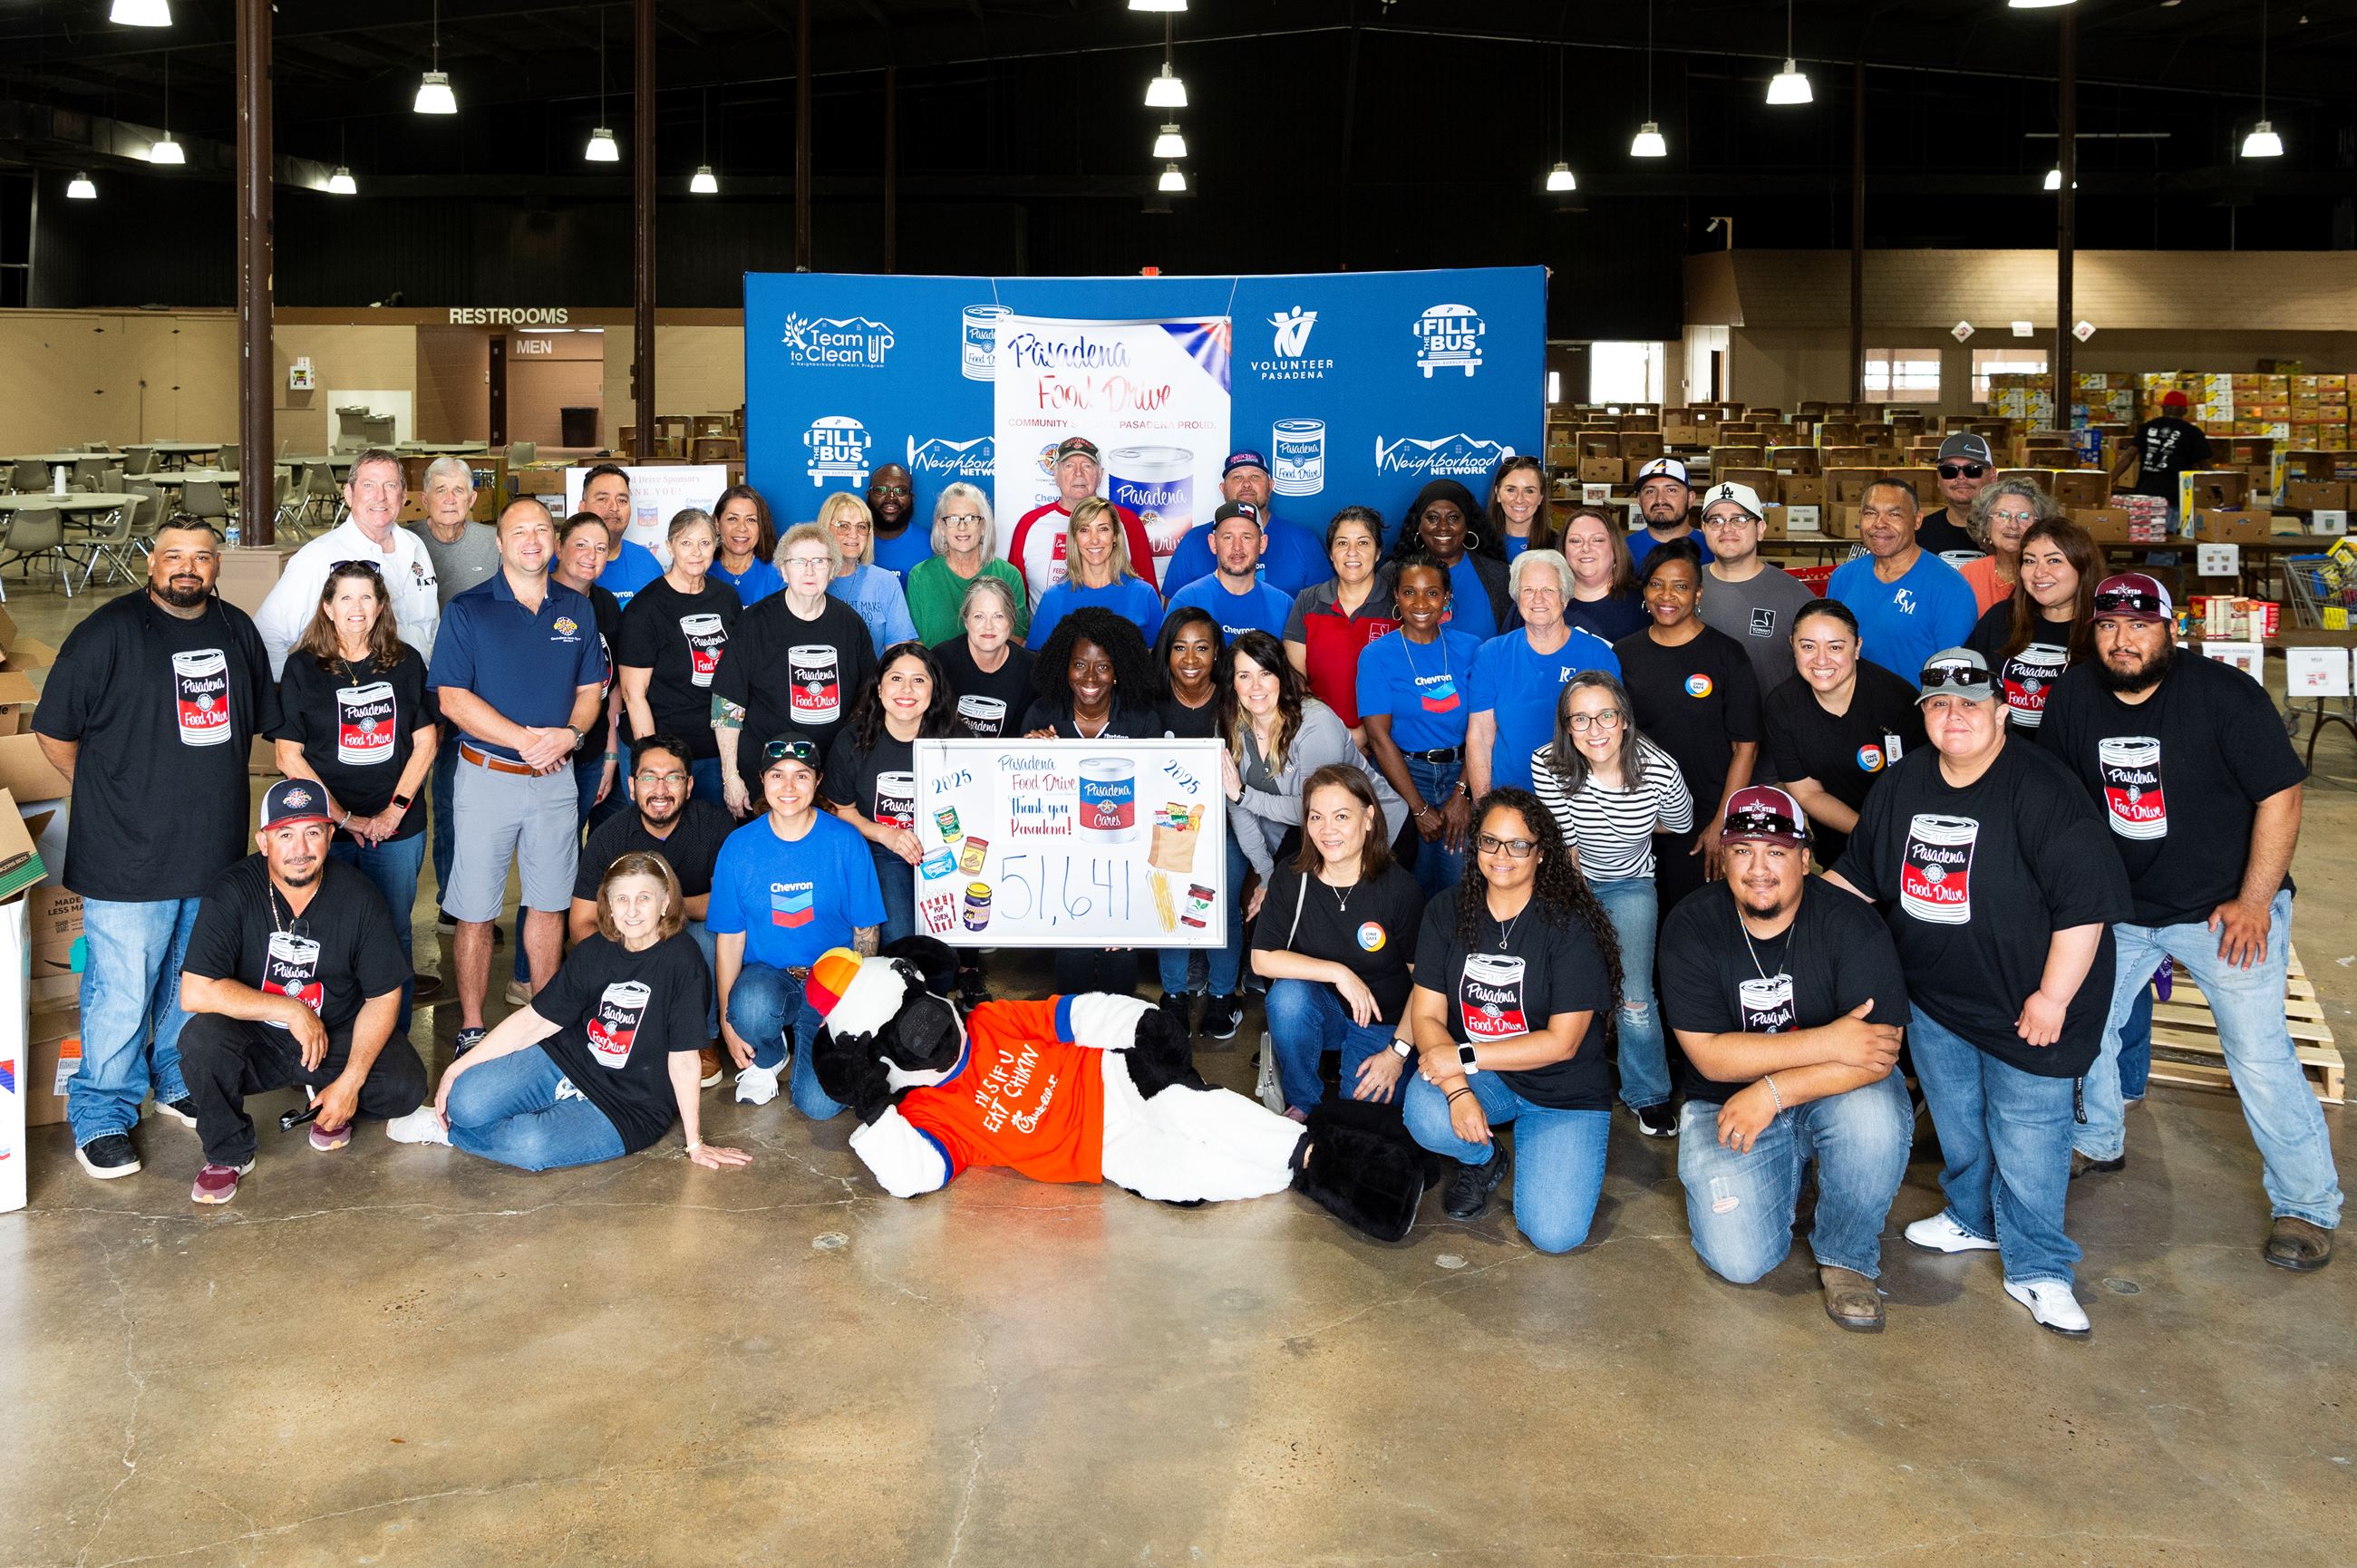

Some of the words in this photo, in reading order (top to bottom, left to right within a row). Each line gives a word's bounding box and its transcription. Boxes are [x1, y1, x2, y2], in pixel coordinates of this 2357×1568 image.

[450, 307, 568, 324] RESTROOMS
[969, 328, 995, 340] Pasad
[1423, 317, 1476, 335] FILL
[810, 330, 863, 346] Team
[1431, 334, 1476, 352] BUS
[516, 340, 552, 354] MEN
[791, 351, 803, 361] to
[806, 346, 863, 363] Clean
[1007, 333, 1131, 369] Pasadena
[968, 353, 986, 364] Food
[1251, 359, 1334, 371] VOLUNTEER
[1261, 371, 1324, 380] PASADENA
[1038, 373, 1095, 411] Food
[1101, 374, 1172, 412] Drive
[1008, 419, 1068, 429] COMMUNITY
[1120, 420, 1175, 430] PASADENA
[813, 429, 862, 447] FILL
[820, 446, 863, 462] BUS
[1279, 442, 1319, 455] Pasadena
[916, 451, 995, 477] Neighbor
[1384, 451, 1502, 477] Neighborhood
[1431, 466, 1487, 476] NETWORK
[1278, 467, 1296, 479] Food
[1297, 467, 1319, 479] Drive
[629, 489, 649, 497] ANK
[1034, 494, 1062, 502] Chevr
[1116, 484, 1188, 507] Pasadena
[1720, 484, 1733, 498] LA
[692, 635, 725, 647] Pasadena
[697, 660, 714, 672] Food
[2011, 663, 2059, 678] Pasadena
[794, 668, 835, 681] Pasadena
[1414, 673, 1452, 686] Chevron
[181, 678, 226, 693] Pasadena
[795, 694, 813, 707] Food
[814, 695, 838, 708] Drive
[2008, 691, 2029, 706] Food
[2030, 694, 2046, 709] Dri
[184, 711, 207, 726] Food
[206, 711, 228, 725] Drive
[344, 702, 392, 719] Pasadena
[344, 733, 365, 746] Food
[365, 732, 392, 745] Drive
[997, 754, 1055, 771] Pasadena
[931, 769, 973, 794] 2025
[1012, 773, 1040, 790] Food
[1043, 773, 1078, 792] Drive
[1162, 759, 1201, 795] 2025
[1084, 782, 1131, 798] Pasadena
[880, 798, 914, 813] Pasade
[1008, 795, 1044, 816] Thank
[1048, 804, 1069, 821] you
[2131, 804, 2164, 820] Drive
[1011, 816, 1072, 837] Pasadena!
[1093, 813, 1121, 828] Cares
[15, 855, 28, 865] BOX
[1911, 843, 1965, 864] Pasadena
[771, 882, 813, 893] Chevron
[1000, 855, 1130, 926] 51,641
[1906, 878, 1932, 898] Food
[1933, 885, 1965, 901] Drive
[54, 895, 82, 906] MADE
[48, 906, 69, 916] LESS
[934, 905, 944, 914] POP
[933, 913, 949, 923] CORN
[1466, 982, 1517, 1003] Pasadena
[603, 1005, 636, 1024] sadena
[1750, 1008, 1792, 1026] Pasana
[1469, 1016, 1493, 1032] Food
[1494, 1019, 1525, 1032] Drive
[592, 1031, 606, 1046] Foo
[603, 1037, 627, 1054] Drive
[998, 1049, 1014, 1064] U
[988, 1064, 1010, 1083] IF
[983, 1097, 1010, 1134] EAT
